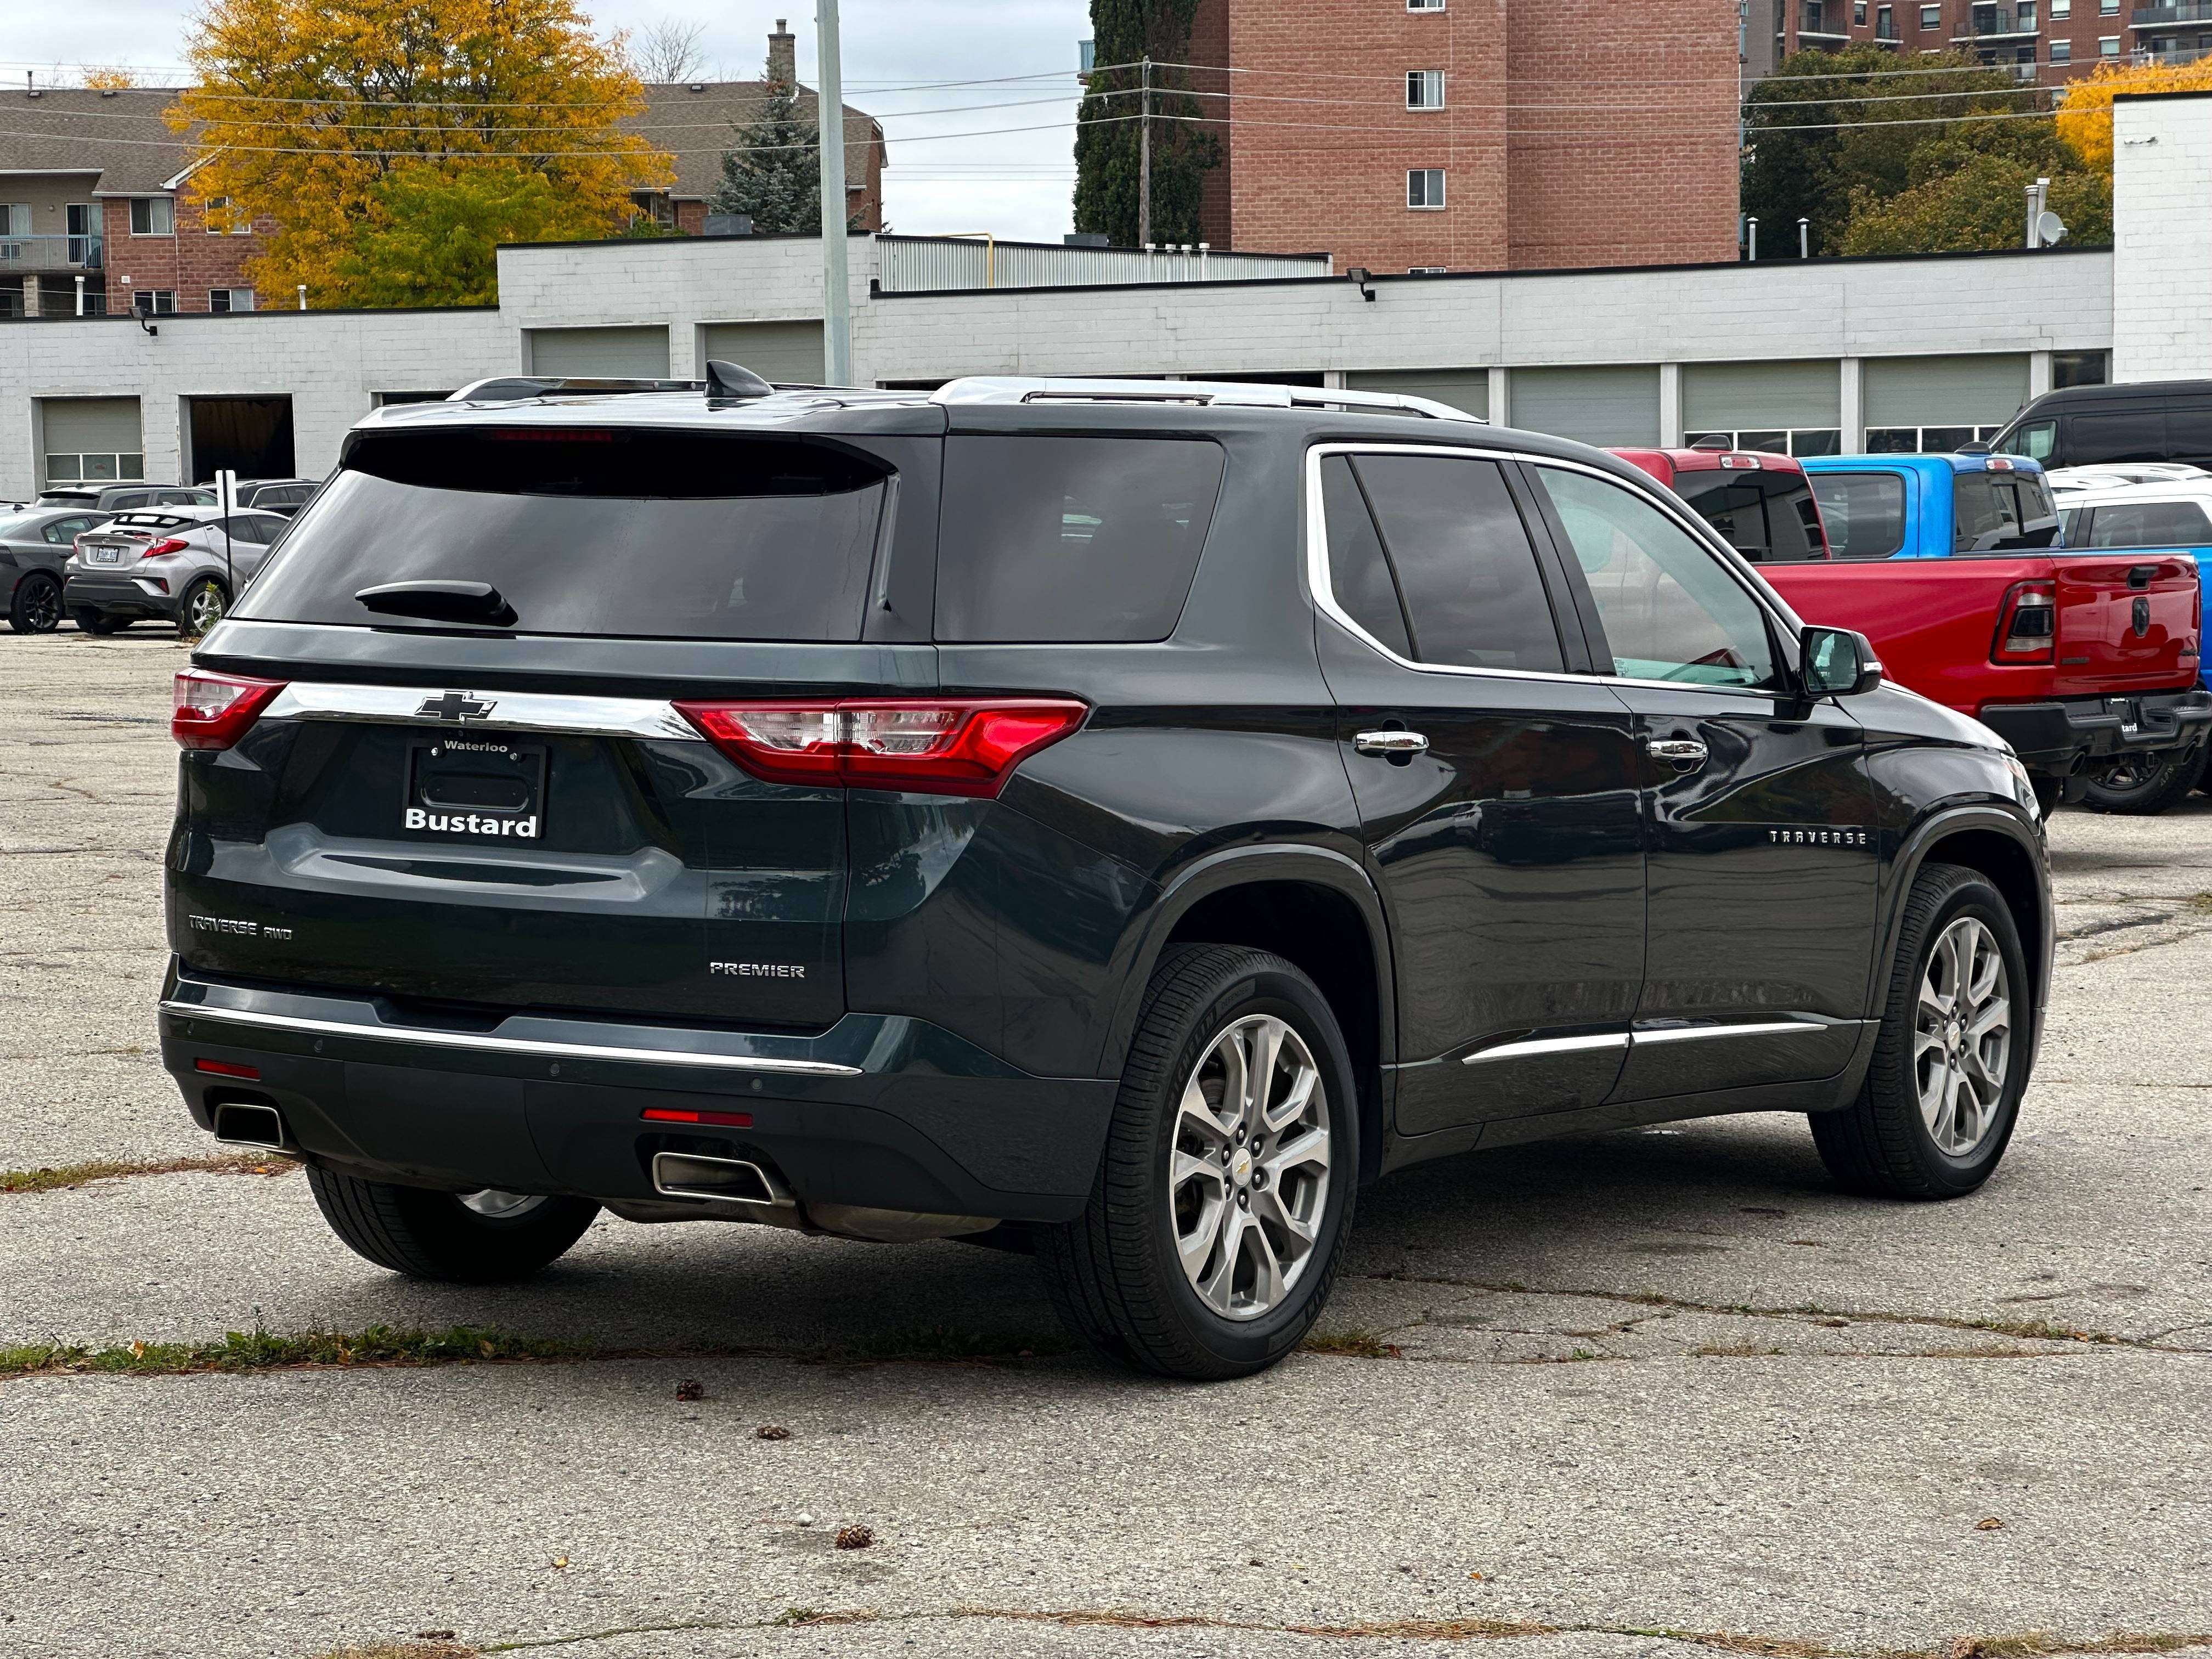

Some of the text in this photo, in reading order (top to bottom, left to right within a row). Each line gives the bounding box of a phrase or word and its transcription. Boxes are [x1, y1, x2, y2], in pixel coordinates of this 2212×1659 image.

[444, 740, 508, 752] Waterloo
[405, 808, 537, 837] Bustard
[1769, 831, 1866, 844] TRAVERSE
[189, 915, 292, 940] TRAVERSE AWD
[710, 962, 805, 978] PREMIER
